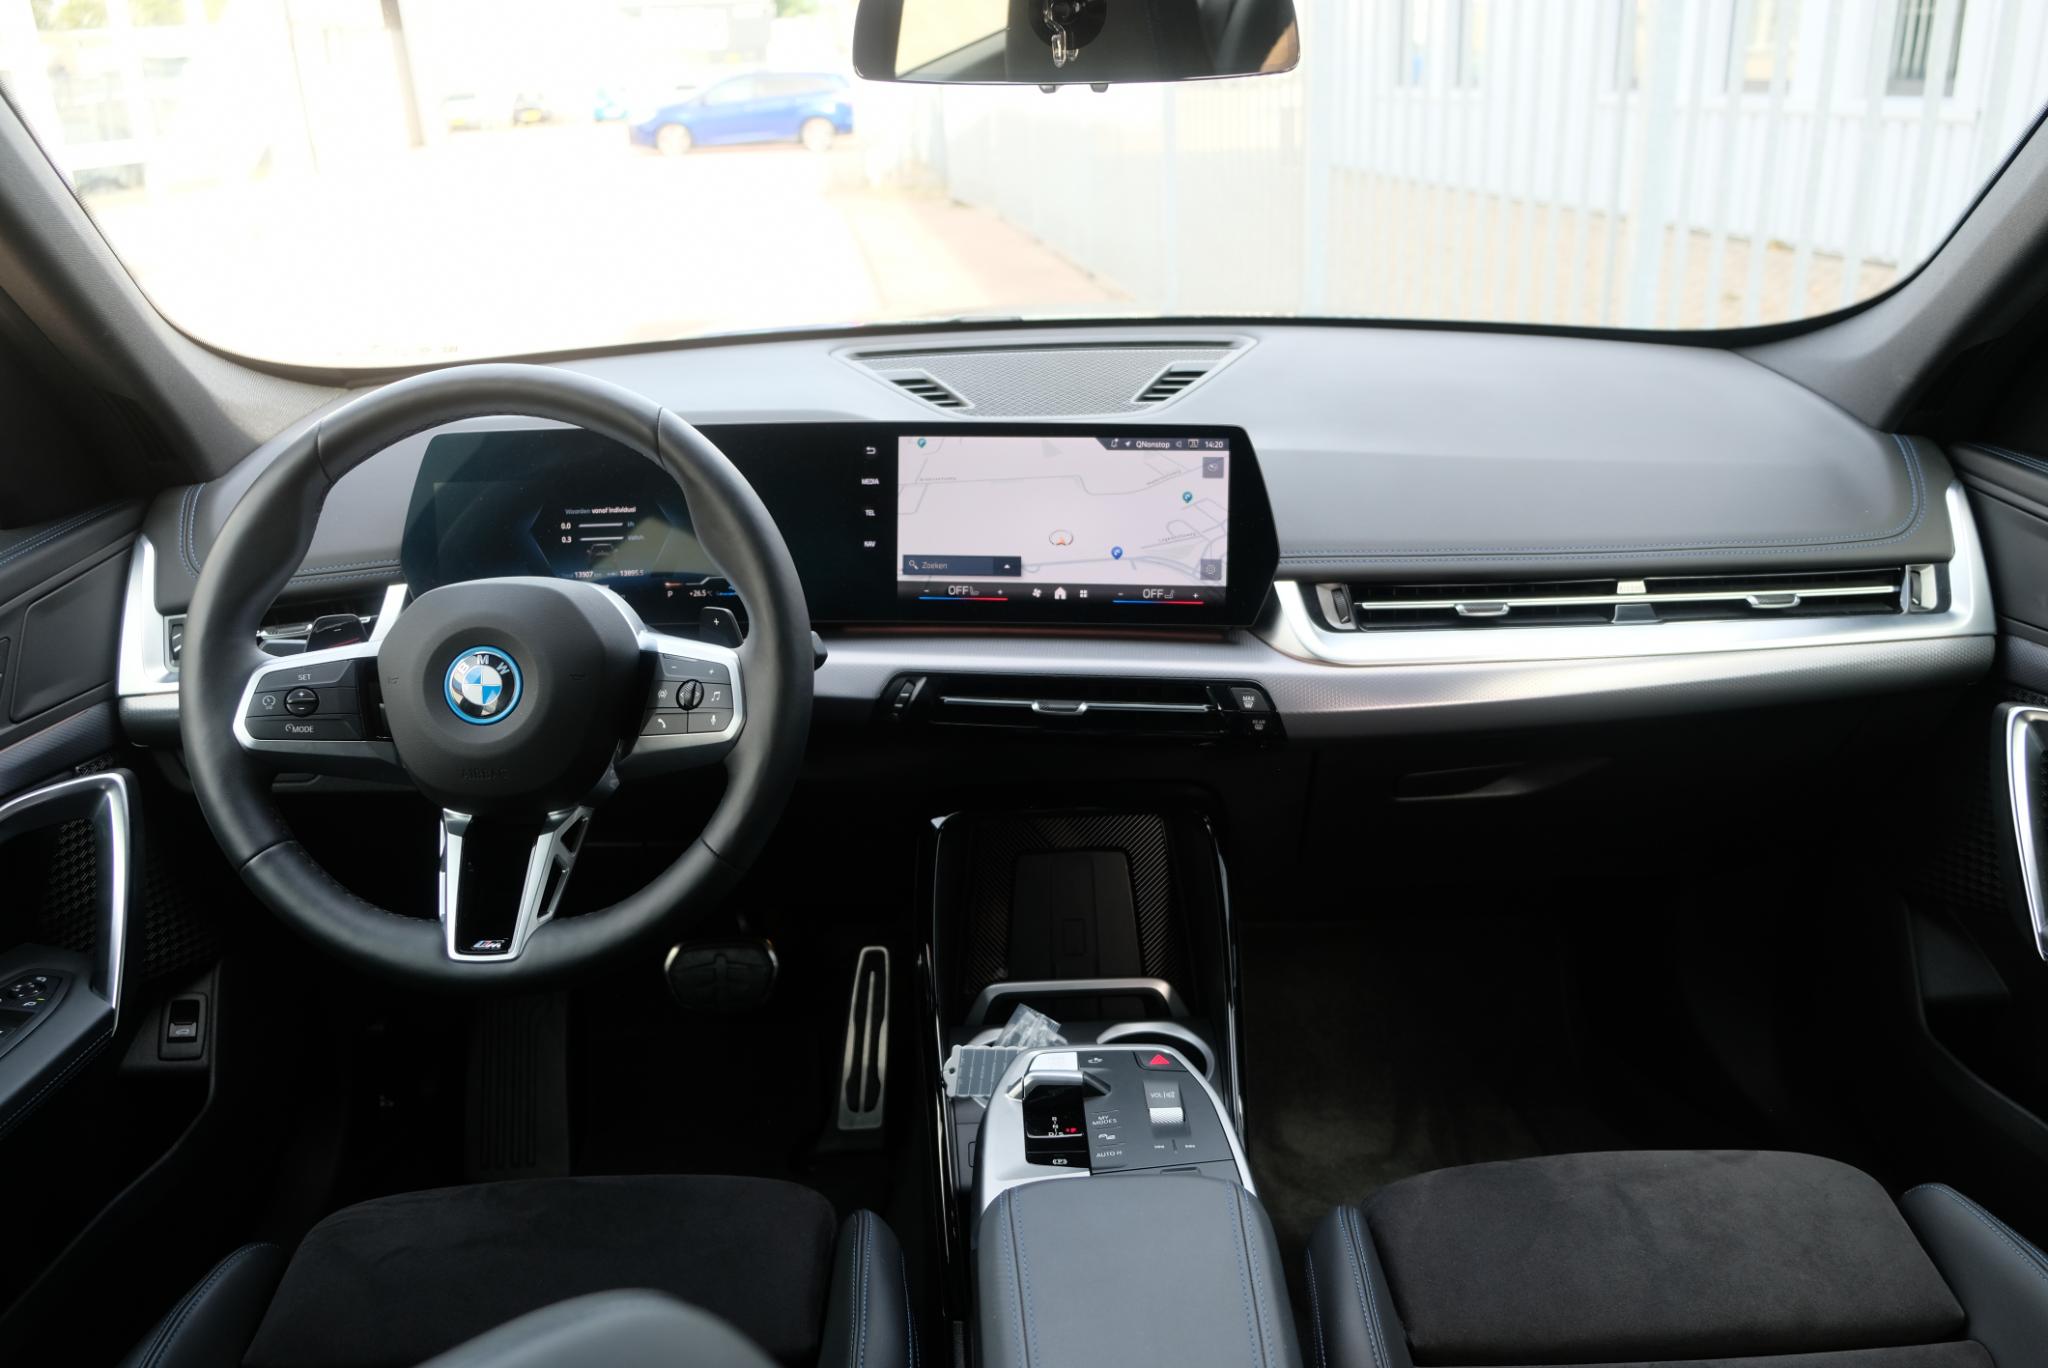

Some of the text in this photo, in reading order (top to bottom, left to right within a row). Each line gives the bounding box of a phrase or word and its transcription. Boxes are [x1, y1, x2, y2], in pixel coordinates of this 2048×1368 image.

[1136, 441, 1170, 449] QNonstop
[591, 506, 608, 514] vanaf
[560, 522, 571, 530] 0.0
[863, 540, 876, 548] NAV
[921, 561, 948, 570] Zoeken
[948, 586, 969, 596] OFF
[1142, 589, 1164, 599] OFF
[457, 654, 511, 675] BMW
[298, 673, 312, 681] SET
[292, 725, 314, 733] MODE
